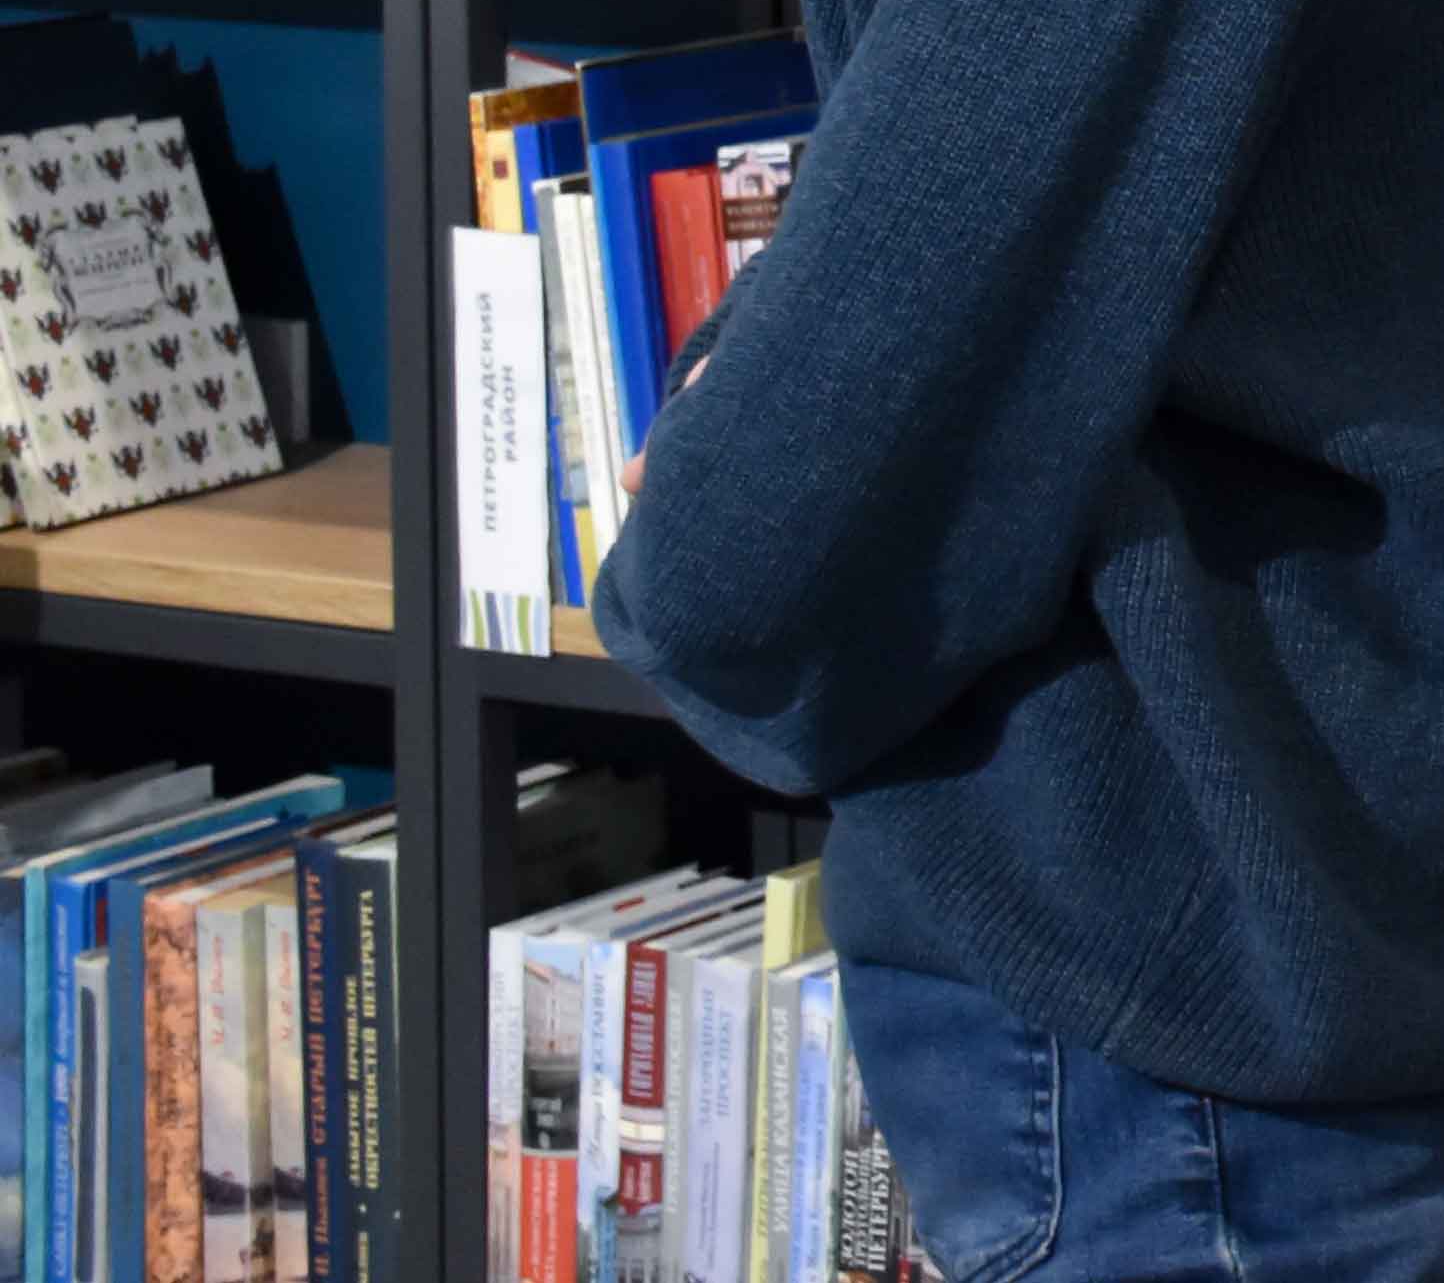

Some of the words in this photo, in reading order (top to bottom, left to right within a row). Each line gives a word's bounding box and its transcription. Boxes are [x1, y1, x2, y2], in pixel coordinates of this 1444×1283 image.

[474, 292, 502, 535] ПЕТРОГРАДСКИЙ
[495, 365, 520, 466] РАЙОН
[304, 866, 325, 1025] ПЕТЕРБУРГ
[359, 889, 377, 1019] ПЕТЕРБУРГА
[343, 974, 360, 1081] ПРОШЛОЕ
[308, 1033, 327, 1146] СТАРЫЙ
[345, 1089, 362, 1188] ЗАБЫТОЕ
[362, 1027, 382, 1190] ОКРЕСТНОСТЕЙ
